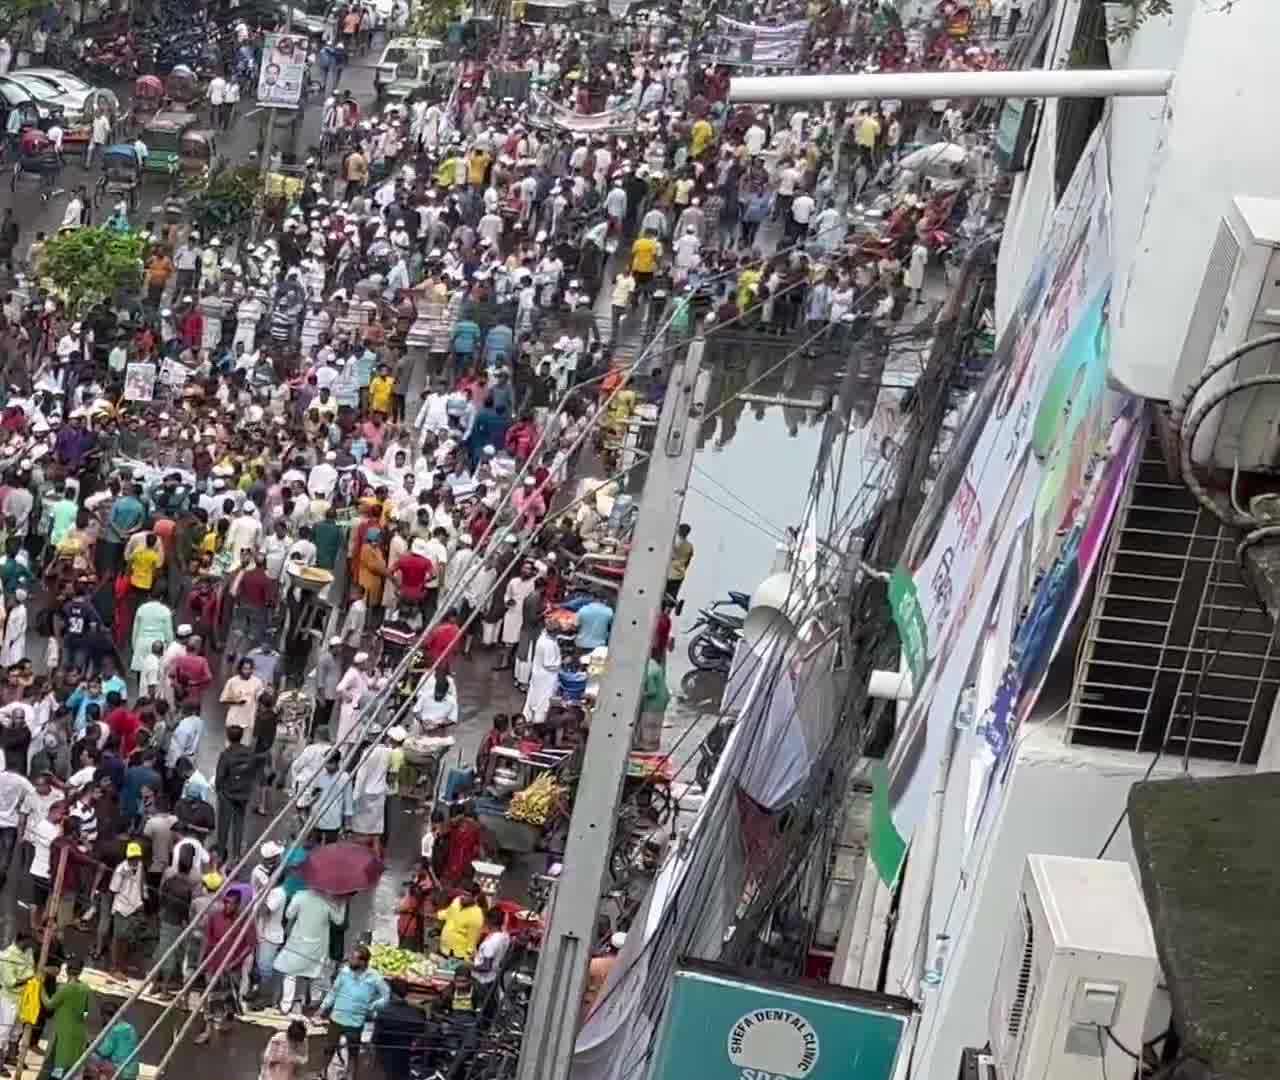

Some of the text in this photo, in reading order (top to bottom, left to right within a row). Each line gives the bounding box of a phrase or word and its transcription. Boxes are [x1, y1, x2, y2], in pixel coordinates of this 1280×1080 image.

[730, 1009, 818, 1072] SHEFA DENTAL CLINIC
